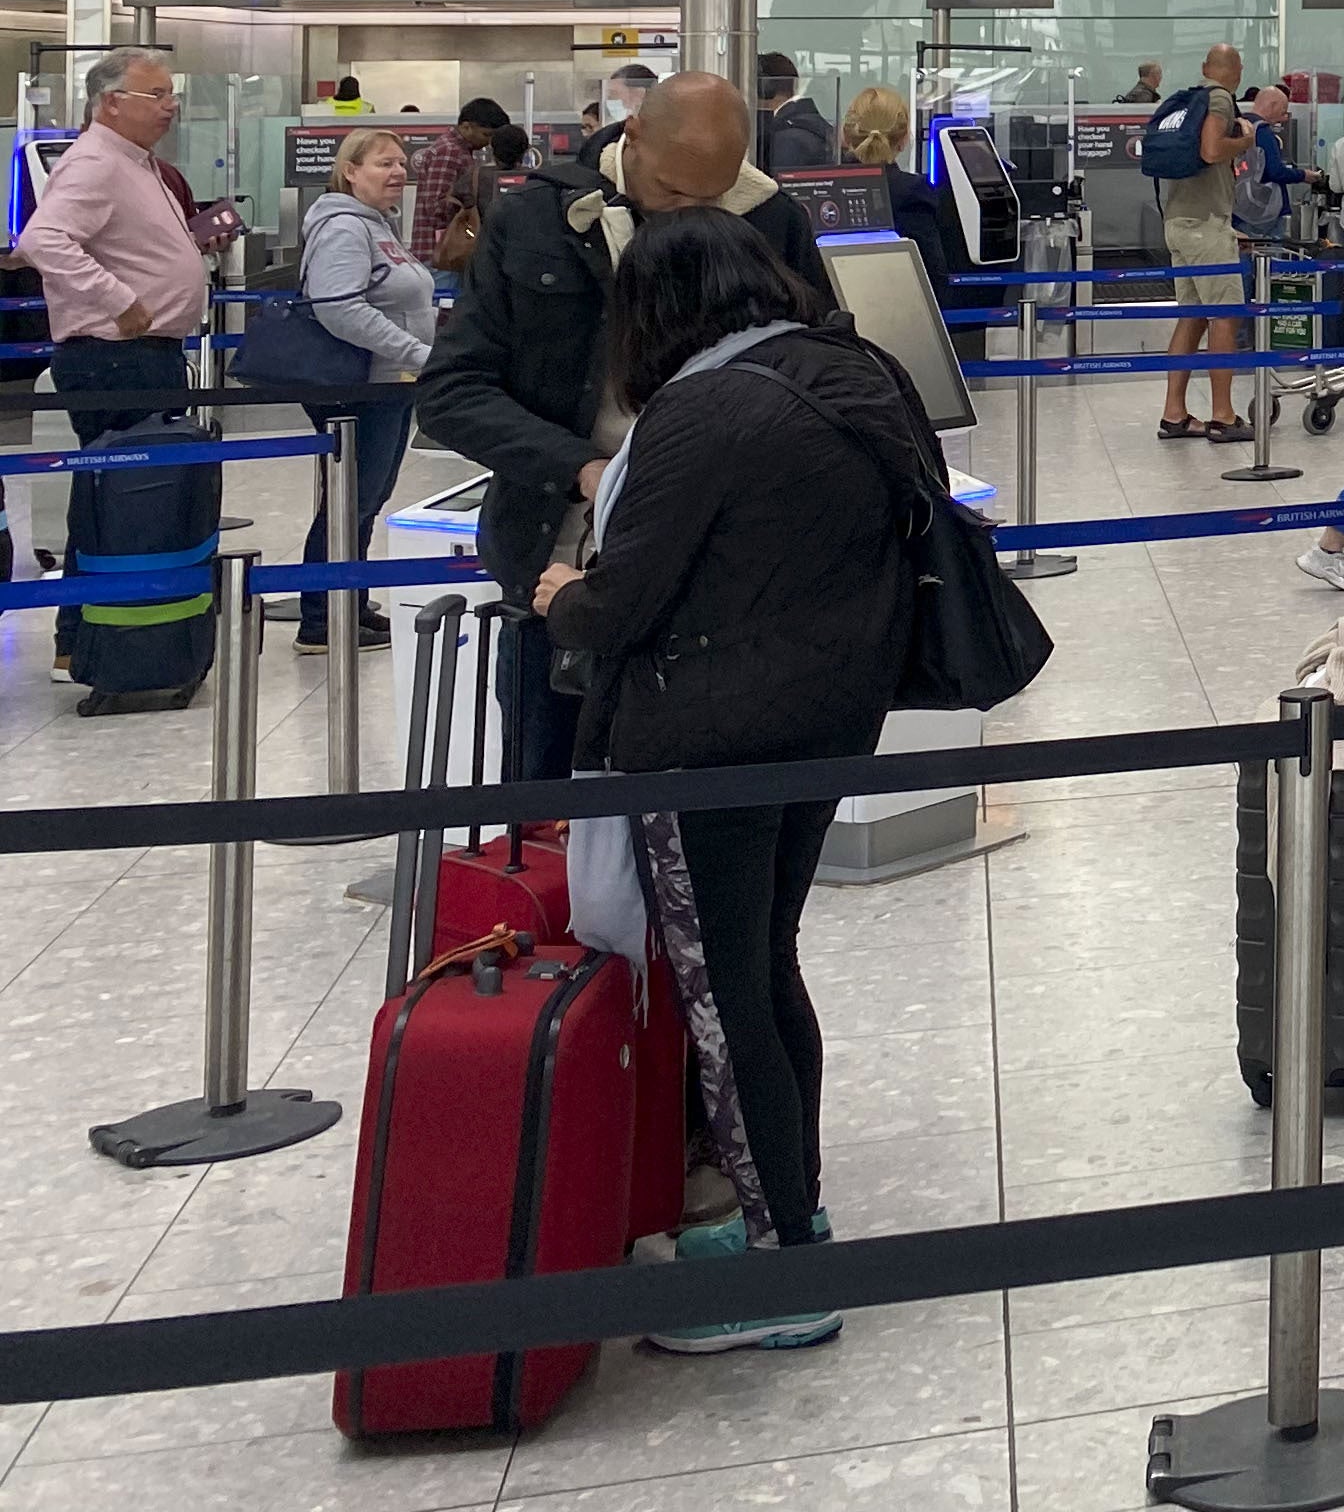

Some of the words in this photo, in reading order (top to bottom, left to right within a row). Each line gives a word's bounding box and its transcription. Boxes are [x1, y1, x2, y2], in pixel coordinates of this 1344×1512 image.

[320, 138, 336, 146] you
[296, 146, 330, 154] checked
[296, 157, 315, 165] your
[67, 456, 105, 466] BRITISH
[108, 453, 149, 463] AIRWAYS
[1277, 510, 1318, 523] BRITISH
